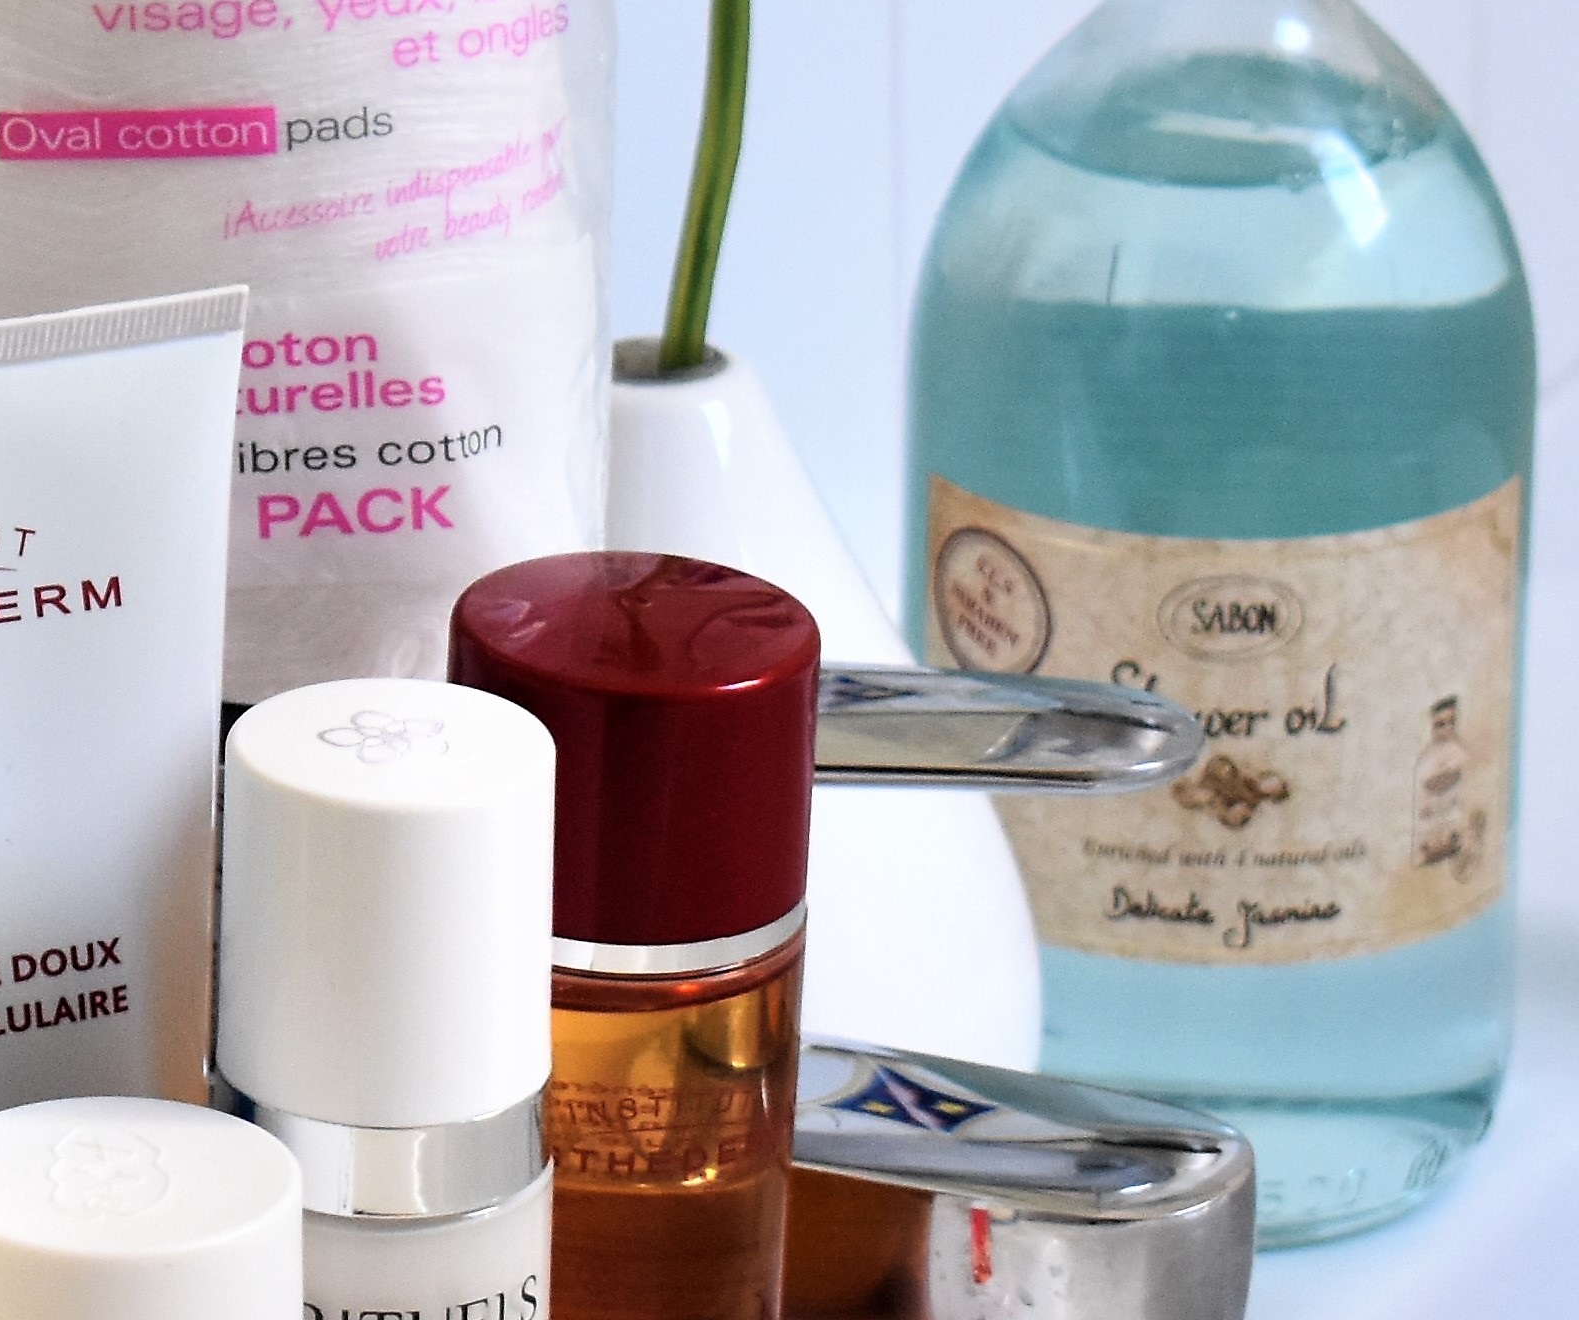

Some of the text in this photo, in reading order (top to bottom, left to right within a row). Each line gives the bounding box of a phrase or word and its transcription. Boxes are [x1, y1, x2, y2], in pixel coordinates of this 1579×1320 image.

[393, 3, 570, 68] et ongles
[2, 106, 394, 151] Oval cotton pads
[242, 330, 380, 370] oton
[236, 370, 446, 417] urelles
[237, 423, 503, 474] ibres cotton
[256, 485, 455, 540] PACK
[1191, 598, 1277, 634] SABON
[11, 937, 122, 984] DOUX
